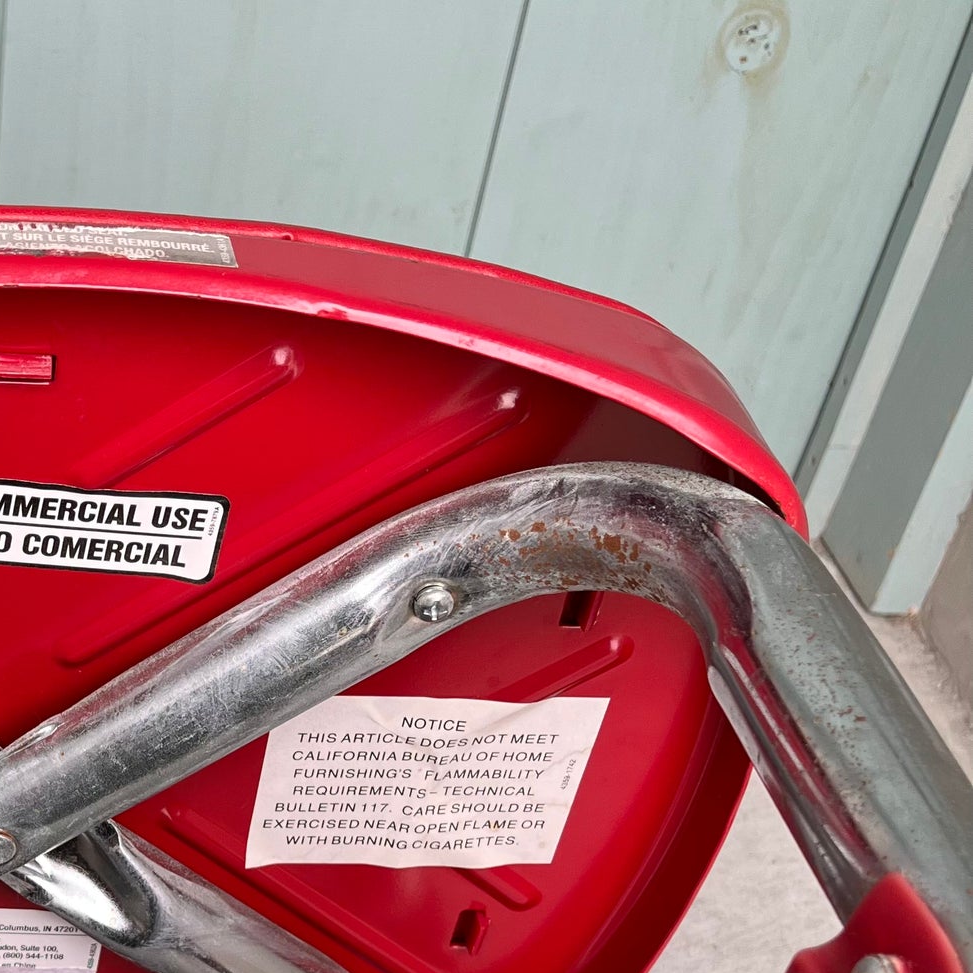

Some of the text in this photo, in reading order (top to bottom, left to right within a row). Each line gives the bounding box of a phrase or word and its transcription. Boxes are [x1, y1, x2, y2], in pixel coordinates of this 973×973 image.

[13, 233, 44, 241] SUR
[48, 234, 67, 242] LE
[70, 233, 113, 245] SIÈGE
[117, 237, 215, 253] REMBOURRÉ.
[152, 505, 208, 532] USE
[22, 533, 187, 568] COMERCIAL
[401, 716, 467, 732] NOTICE
[297, 732, 560, 749] THIS ARTICLE DOES NOT MEET
[292, 750, 554, 766] CALIFORNIA BUREAU OF HOME
[293, 767, 545, 781] FURNISHING'S FLAMMABILITY
[292, 785, 426, 799] REQUIREMENTS
[442, 786, 535, 797] TECHNICAL
[274, 802, 545, 817] BULLETIN 117. CARE SHOULD BE
[262, 819, 545, 834] EXERCISED NEAR OPEN FLAME OR
[285, 835, 520, 851] WITH BURNING CIGARETTES.
[0, 924, 41, 932] Columbus,
